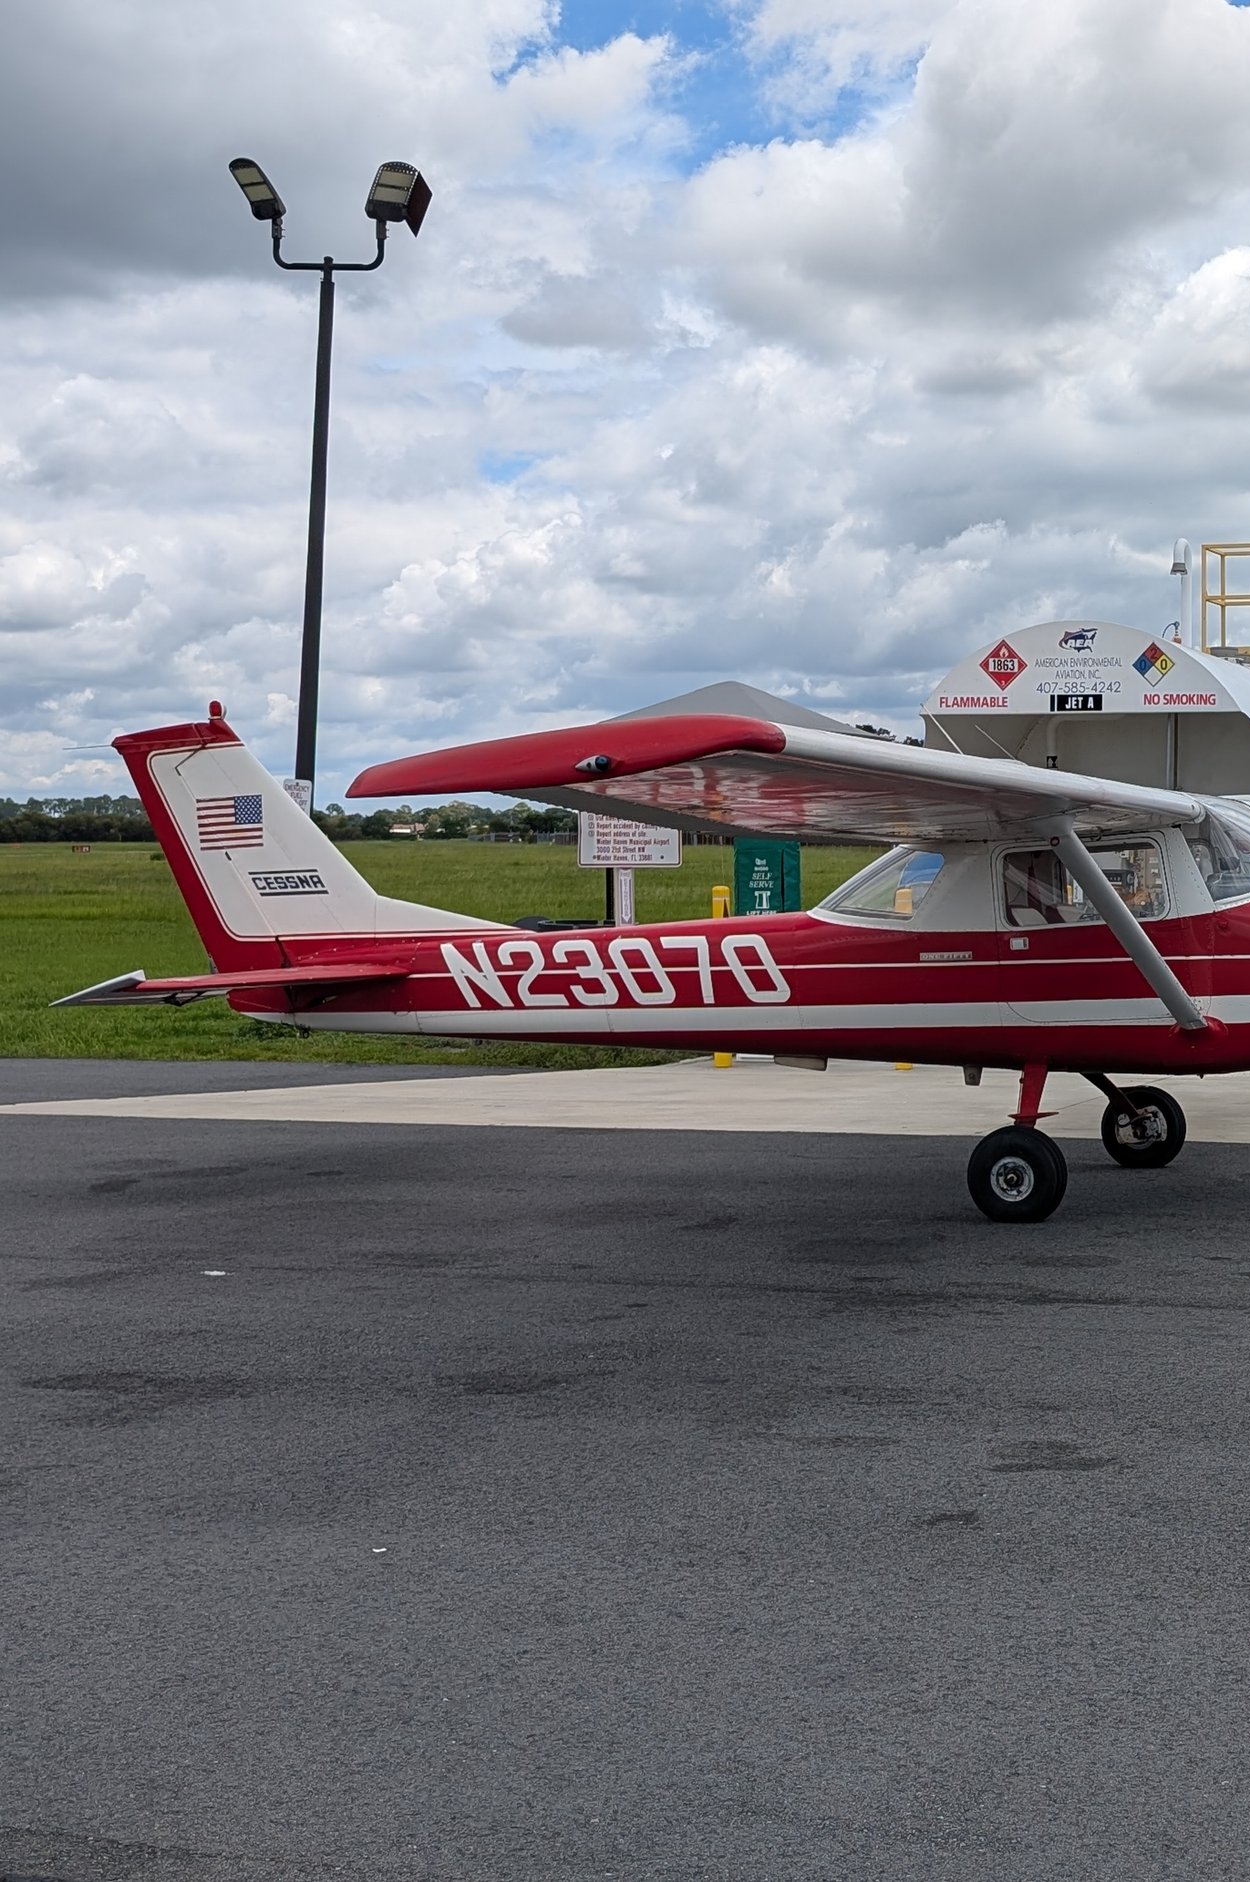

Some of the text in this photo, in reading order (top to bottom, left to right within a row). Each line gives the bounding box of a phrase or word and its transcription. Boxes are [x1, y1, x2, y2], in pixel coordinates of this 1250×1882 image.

[1067, 639, 1092, 648] AEA
[1149, 648, 1158, 660] 2
[992, 659, 1015, 671] 1863
[1034, 656, 1122, 668] AMERICAN ENVIRONMENTAL
[1160, 658, 1167, 671] 0
[1088, 669, 1101, 679] INC.
[1036, 681, 1121, 693] 407-585-4242
[939, 696, 1008, 708] FLAMMABLE
[1065, 697, 1094, 709] JET A
[1144, 694, 1216, 705] NO SMOKING
[653, 839, 670, 847] Airport
[251, 875, 326, 890] CESSNA
[440, 934, 791, 1008] N23070
